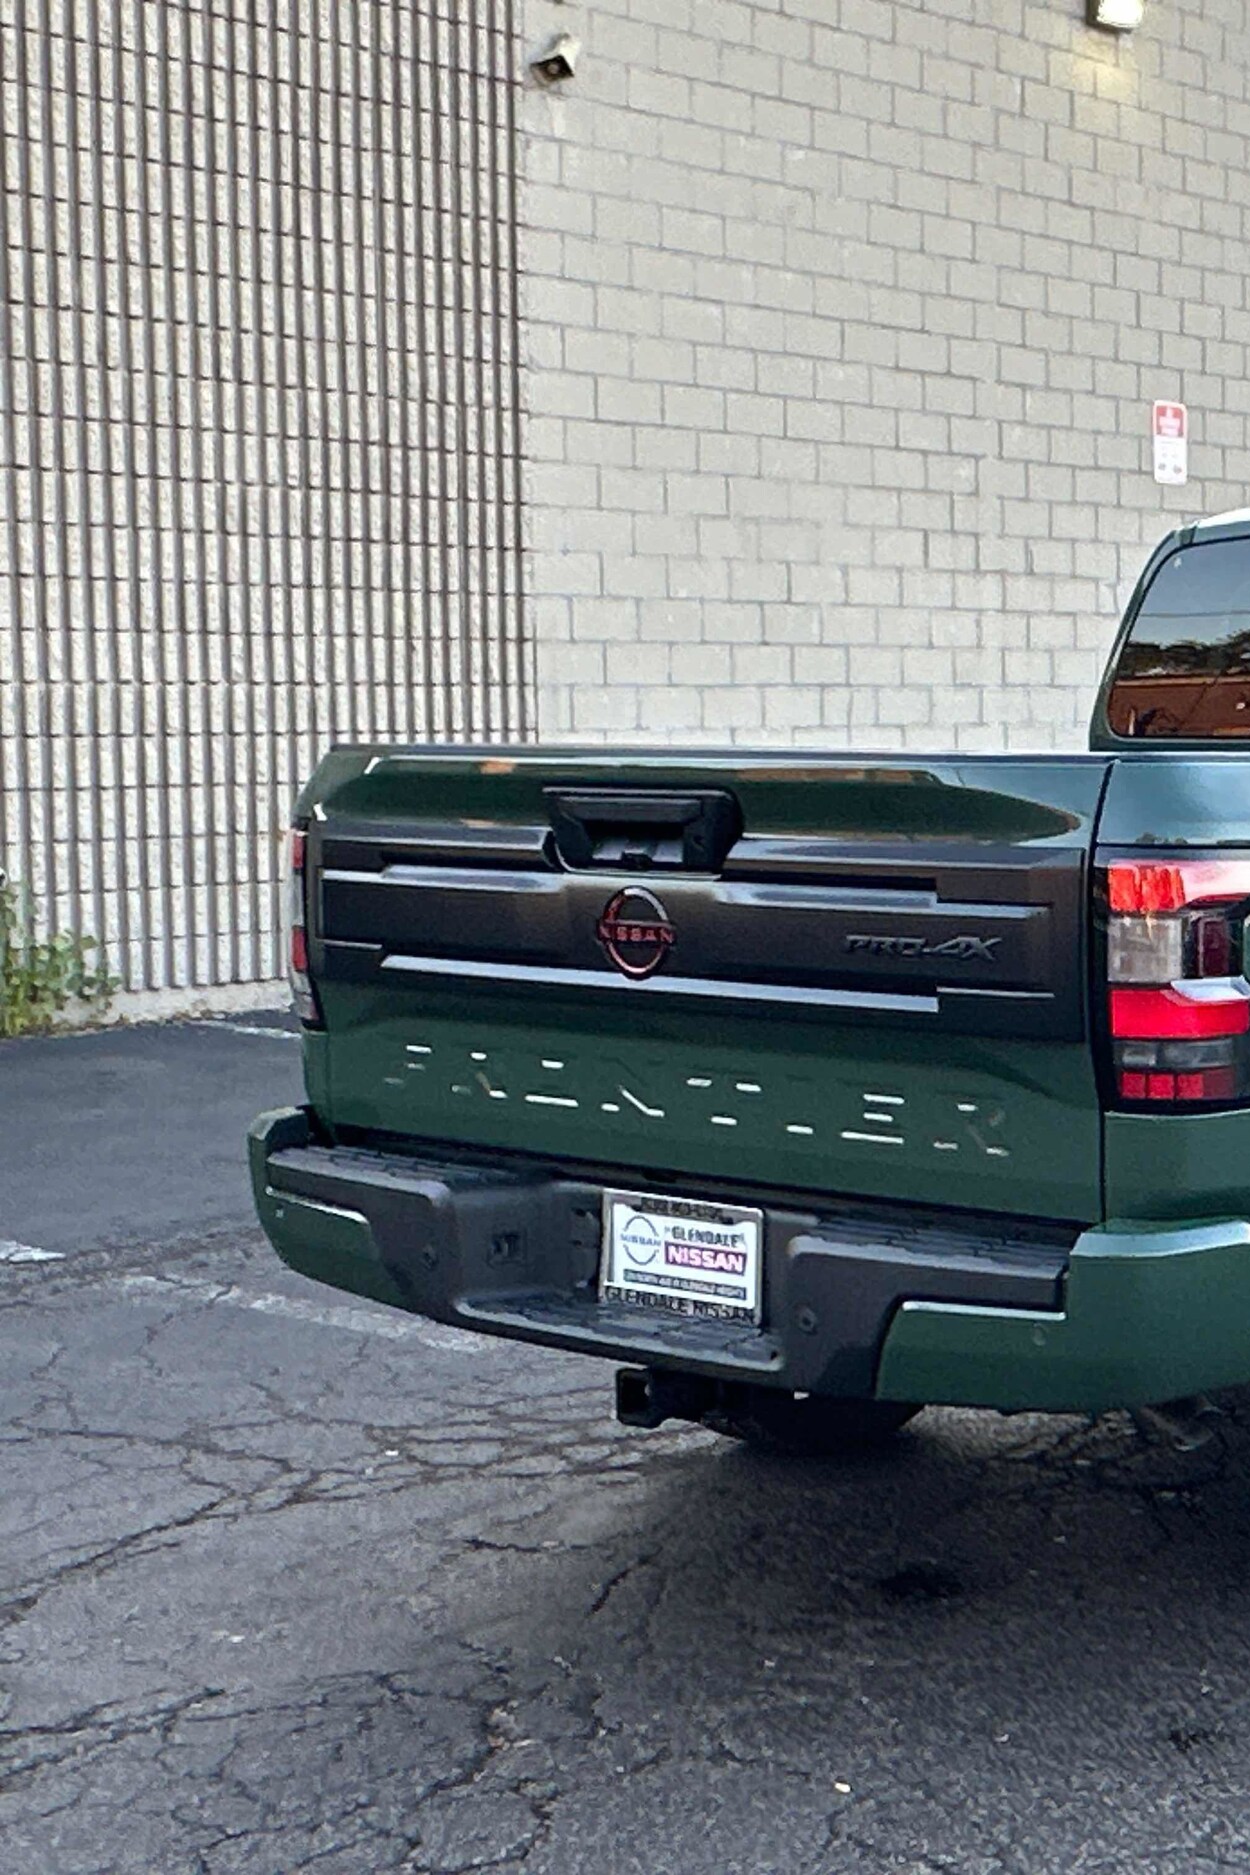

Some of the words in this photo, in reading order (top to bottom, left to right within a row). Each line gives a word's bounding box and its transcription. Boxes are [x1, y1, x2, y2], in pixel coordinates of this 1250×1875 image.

[598, 924, 674, 944] NISSAN
[846, 934, 1003, 961] PRO-4X
[620, 1232, 662, 1247] NISSAN
[671, 1225, 740, 1248] GLENDALE
[667, 1245, 744, 1272] NISSAN
